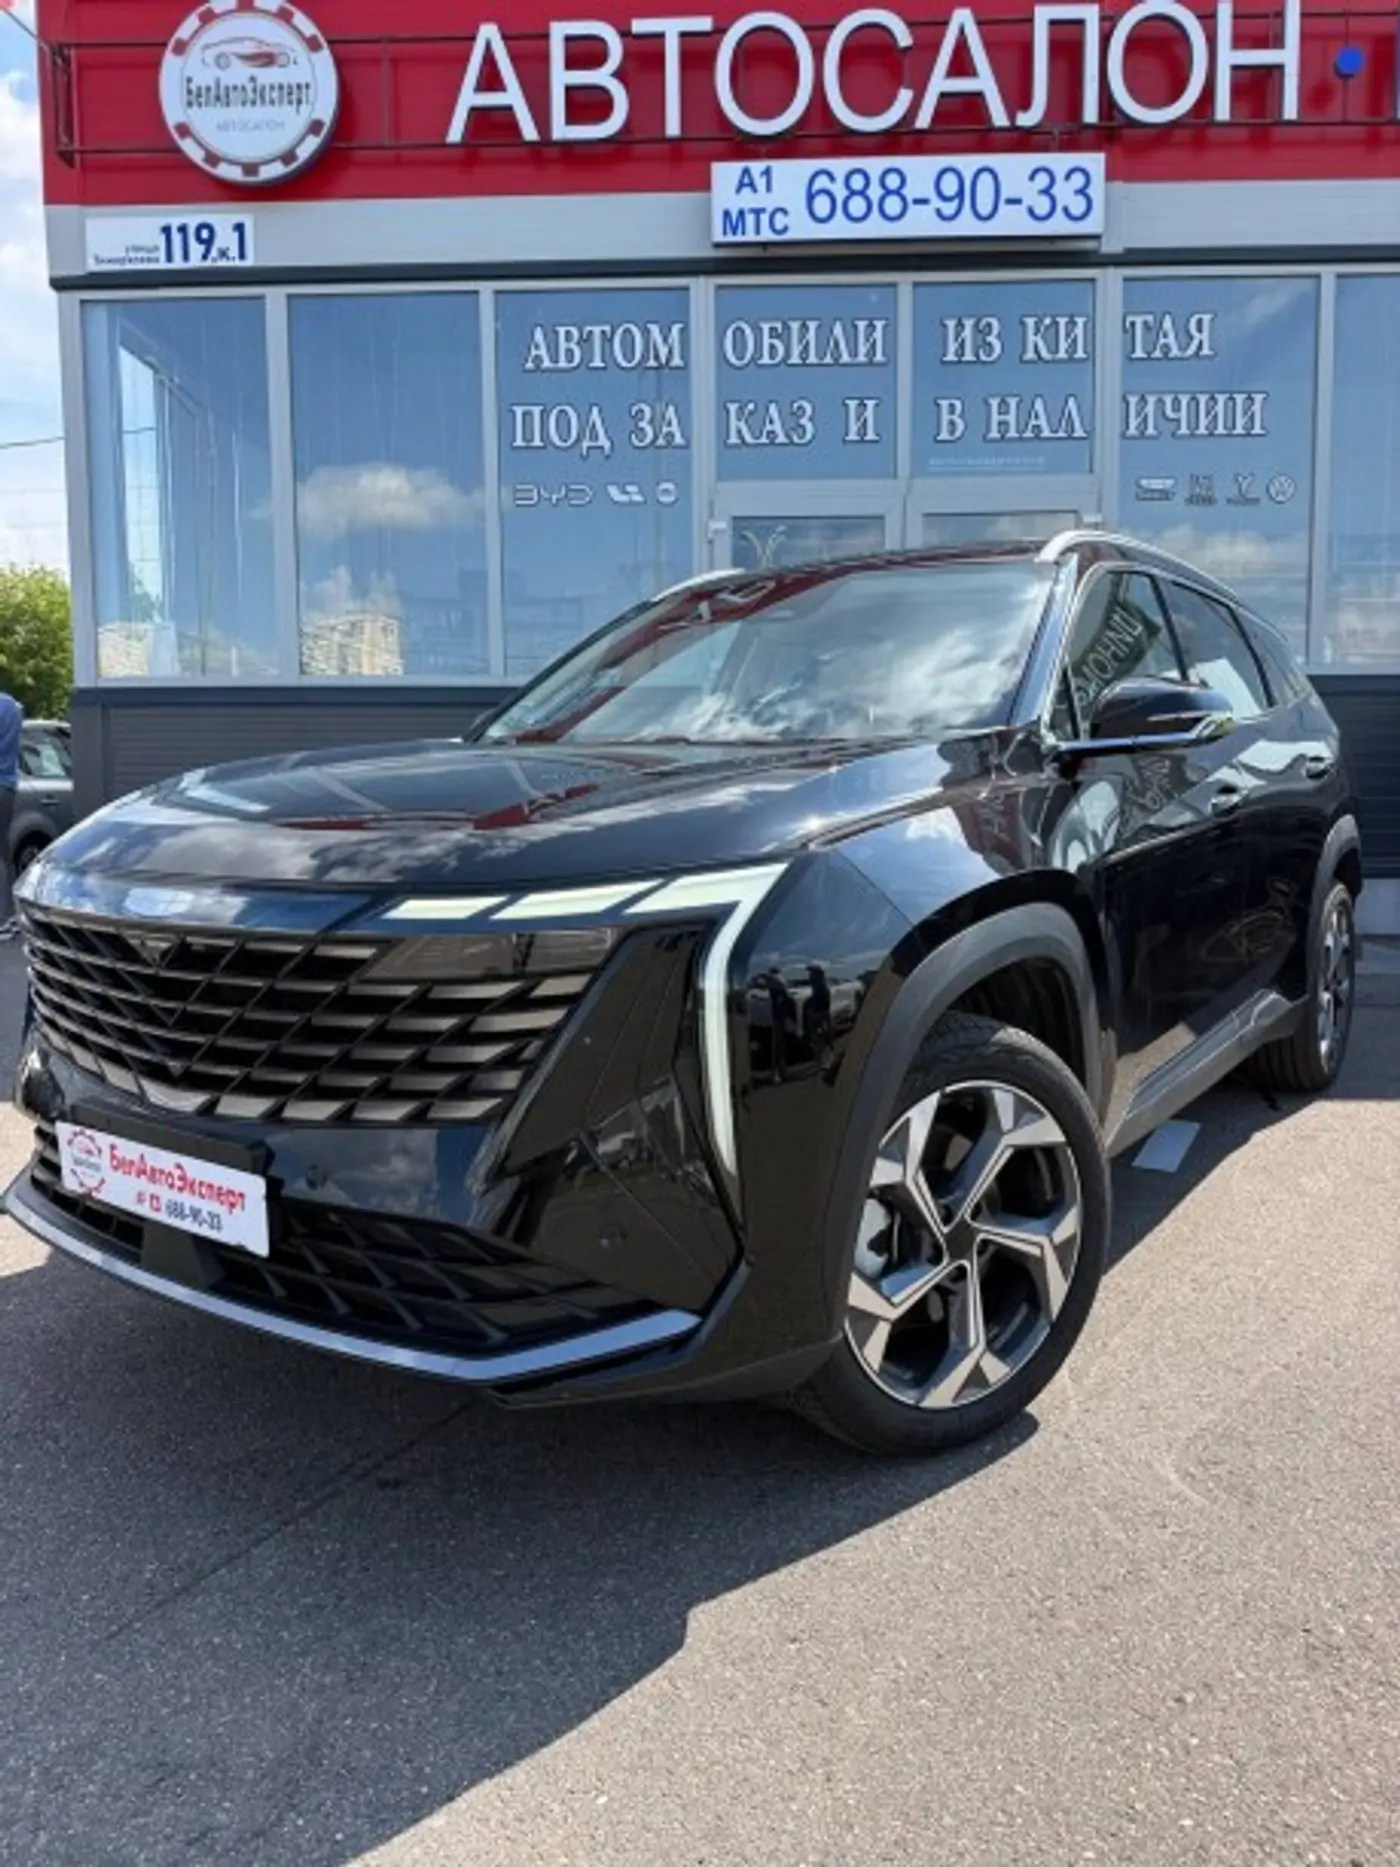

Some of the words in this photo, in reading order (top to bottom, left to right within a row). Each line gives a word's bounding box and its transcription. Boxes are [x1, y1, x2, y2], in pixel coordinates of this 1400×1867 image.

[445, 0, 1301, 144] АВТОСАЛОН
[805, 165, 1094, 224] 688-90-33
[941, 316, 1003, 363] ИЗ
[511, 403, 613, 460] ПОД
[843, 397, 881, 442] И
[934, 397, 967, 443] В
